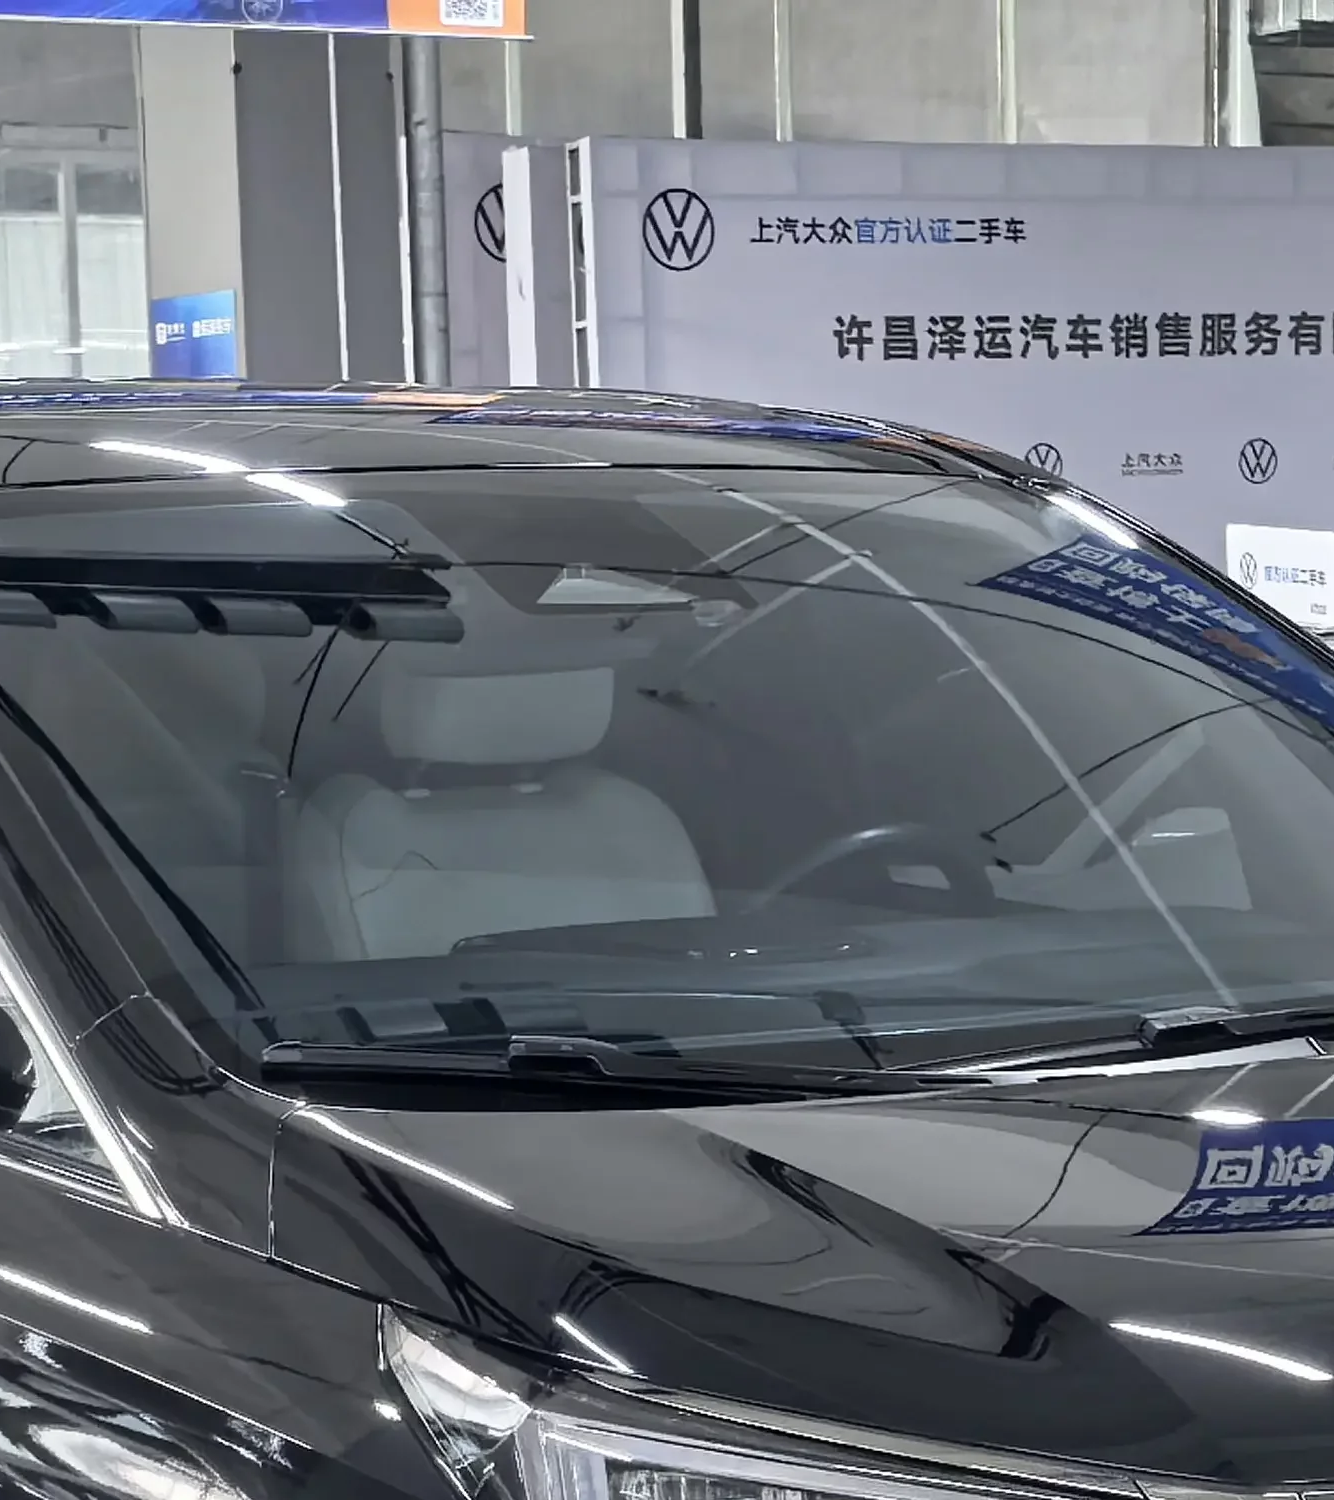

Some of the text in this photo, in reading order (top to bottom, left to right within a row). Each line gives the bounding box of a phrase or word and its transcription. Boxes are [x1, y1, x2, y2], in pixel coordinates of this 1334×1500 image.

[750, 216, 1027, 245] 上汽大众官方认证二手车
